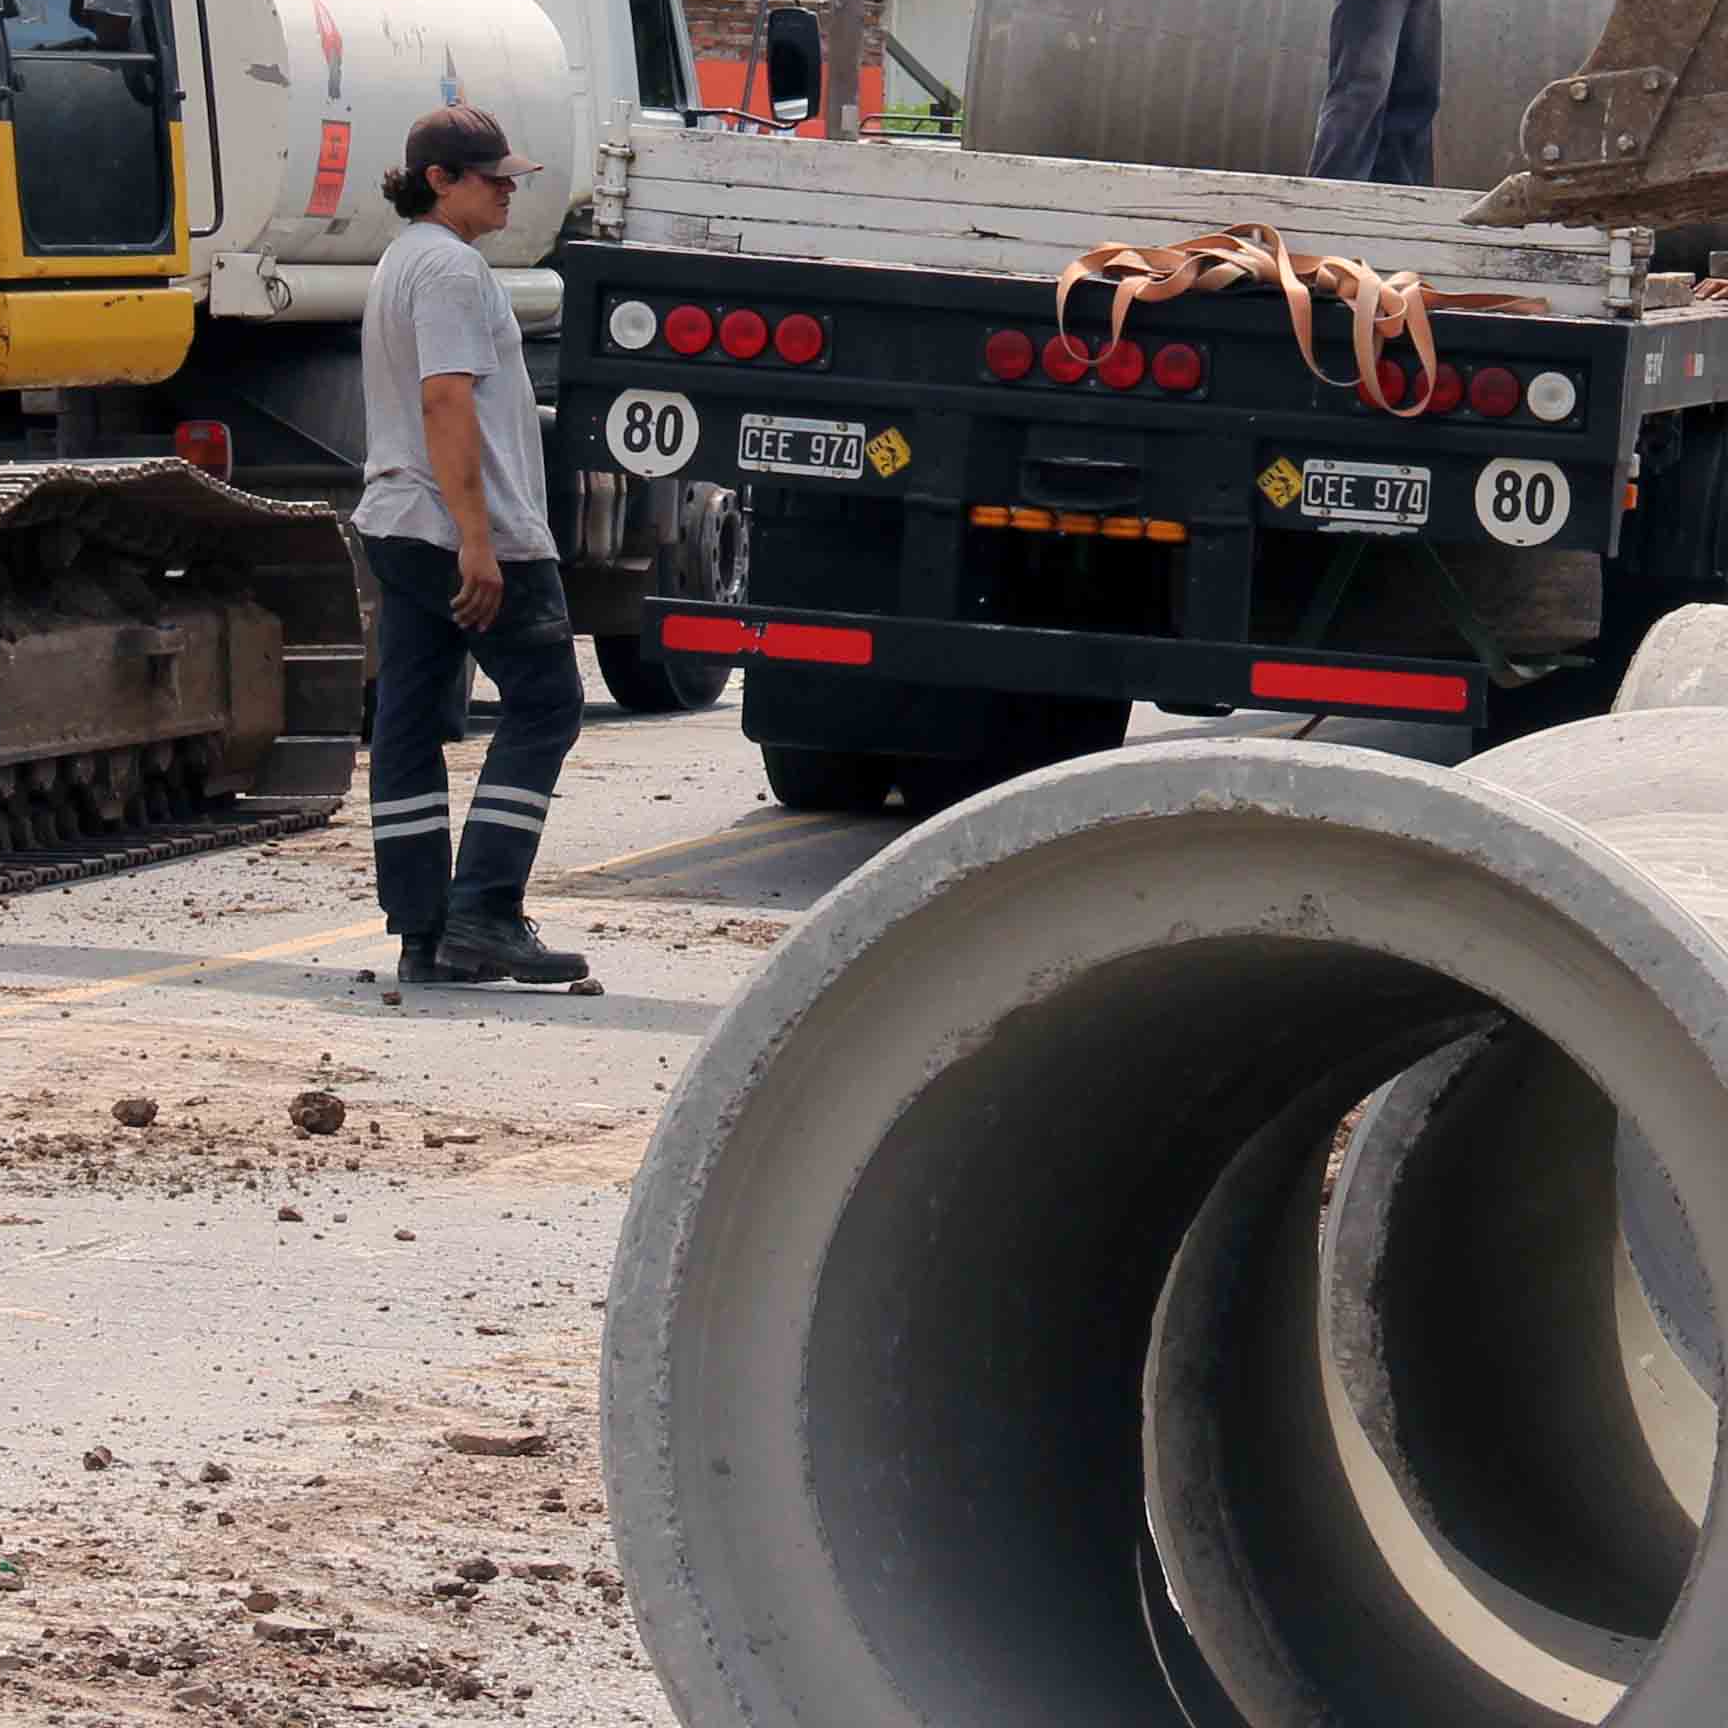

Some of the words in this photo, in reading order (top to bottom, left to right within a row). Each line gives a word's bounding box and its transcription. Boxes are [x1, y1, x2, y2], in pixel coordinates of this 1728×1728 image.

[623, 401, 684, 456] 80
[744, 428, 793, 462] CEE
[809, 435, 859, 468] 974
[1306, 473, 1357, 508] CEE
[1374, 479, 1423, 513] 974
[1492, 469, 1554, 525] 80
